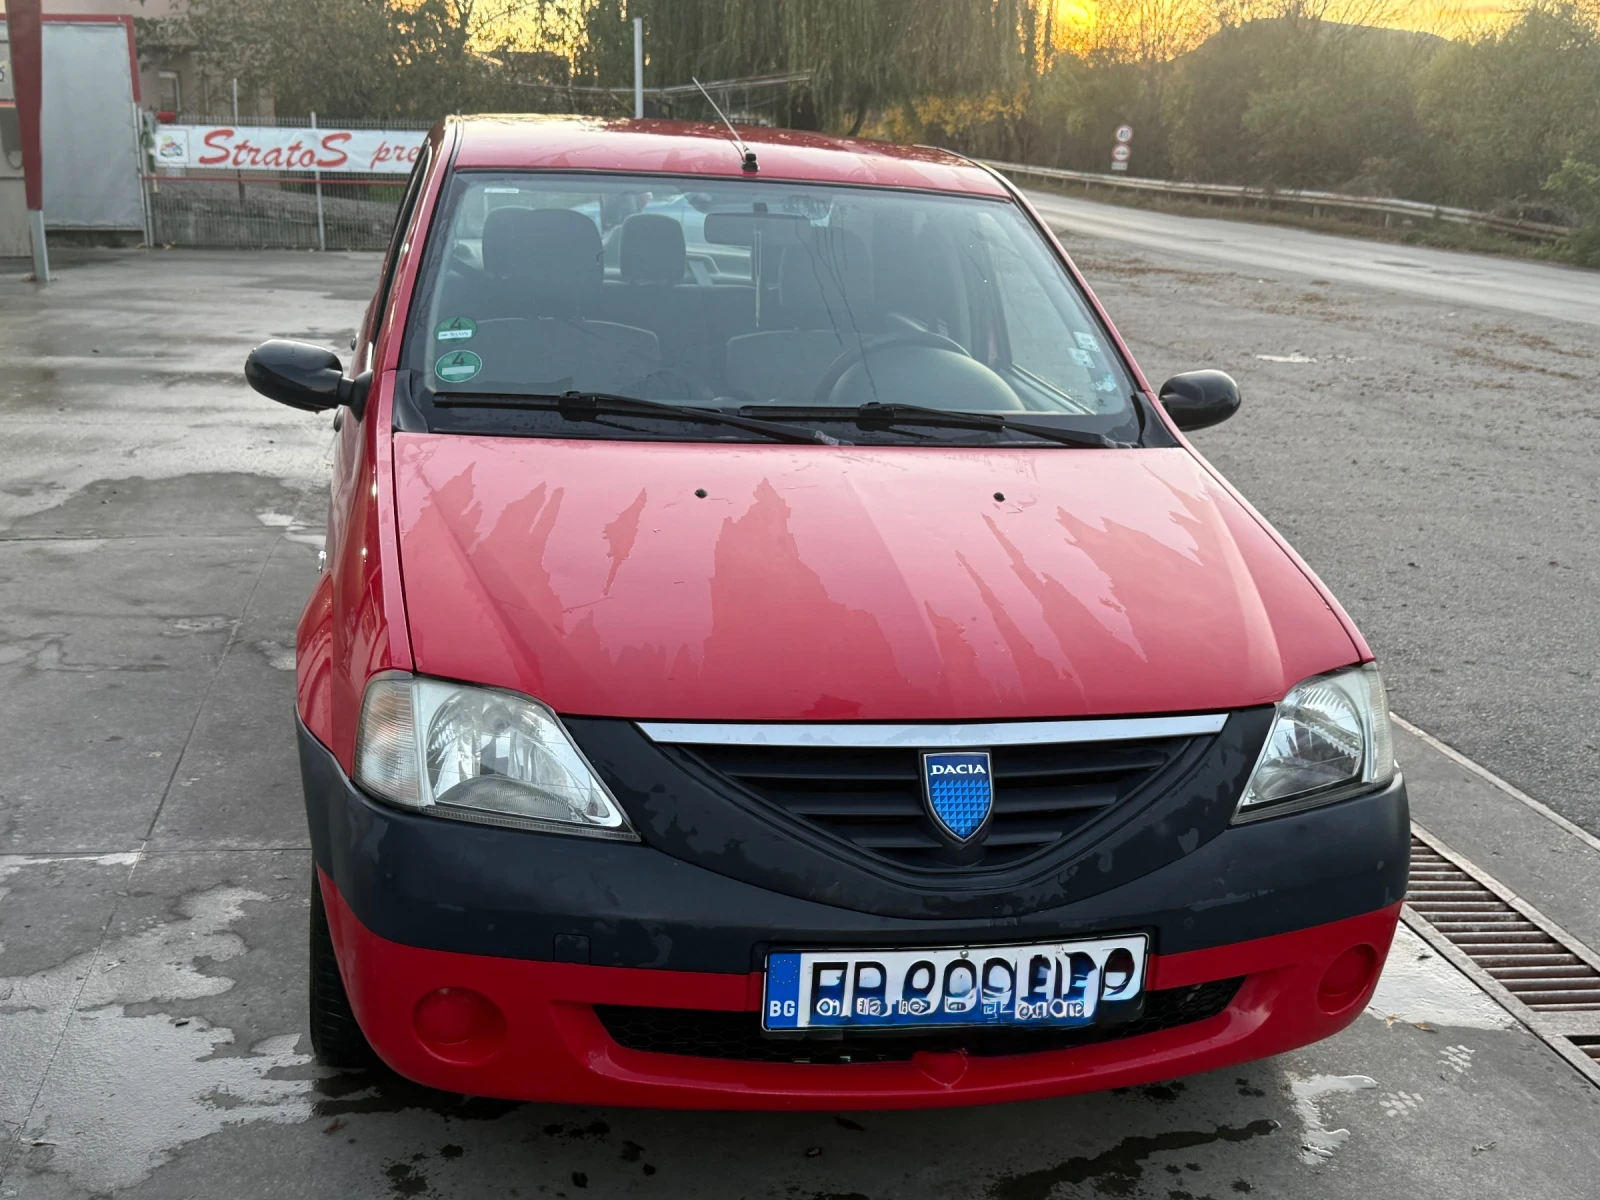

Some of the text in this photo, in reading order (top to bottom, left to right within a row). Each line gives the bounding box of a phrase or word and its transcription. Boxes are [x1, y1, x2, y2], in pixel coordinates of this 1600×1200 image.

[199, 128, 352, 168] StratoS
[451, 317, 462, 330] 4
[452, 352, 465, 366] 4
[930, 764, 987, 776] DACIA
[769, 1000, 796, 1017] BG
